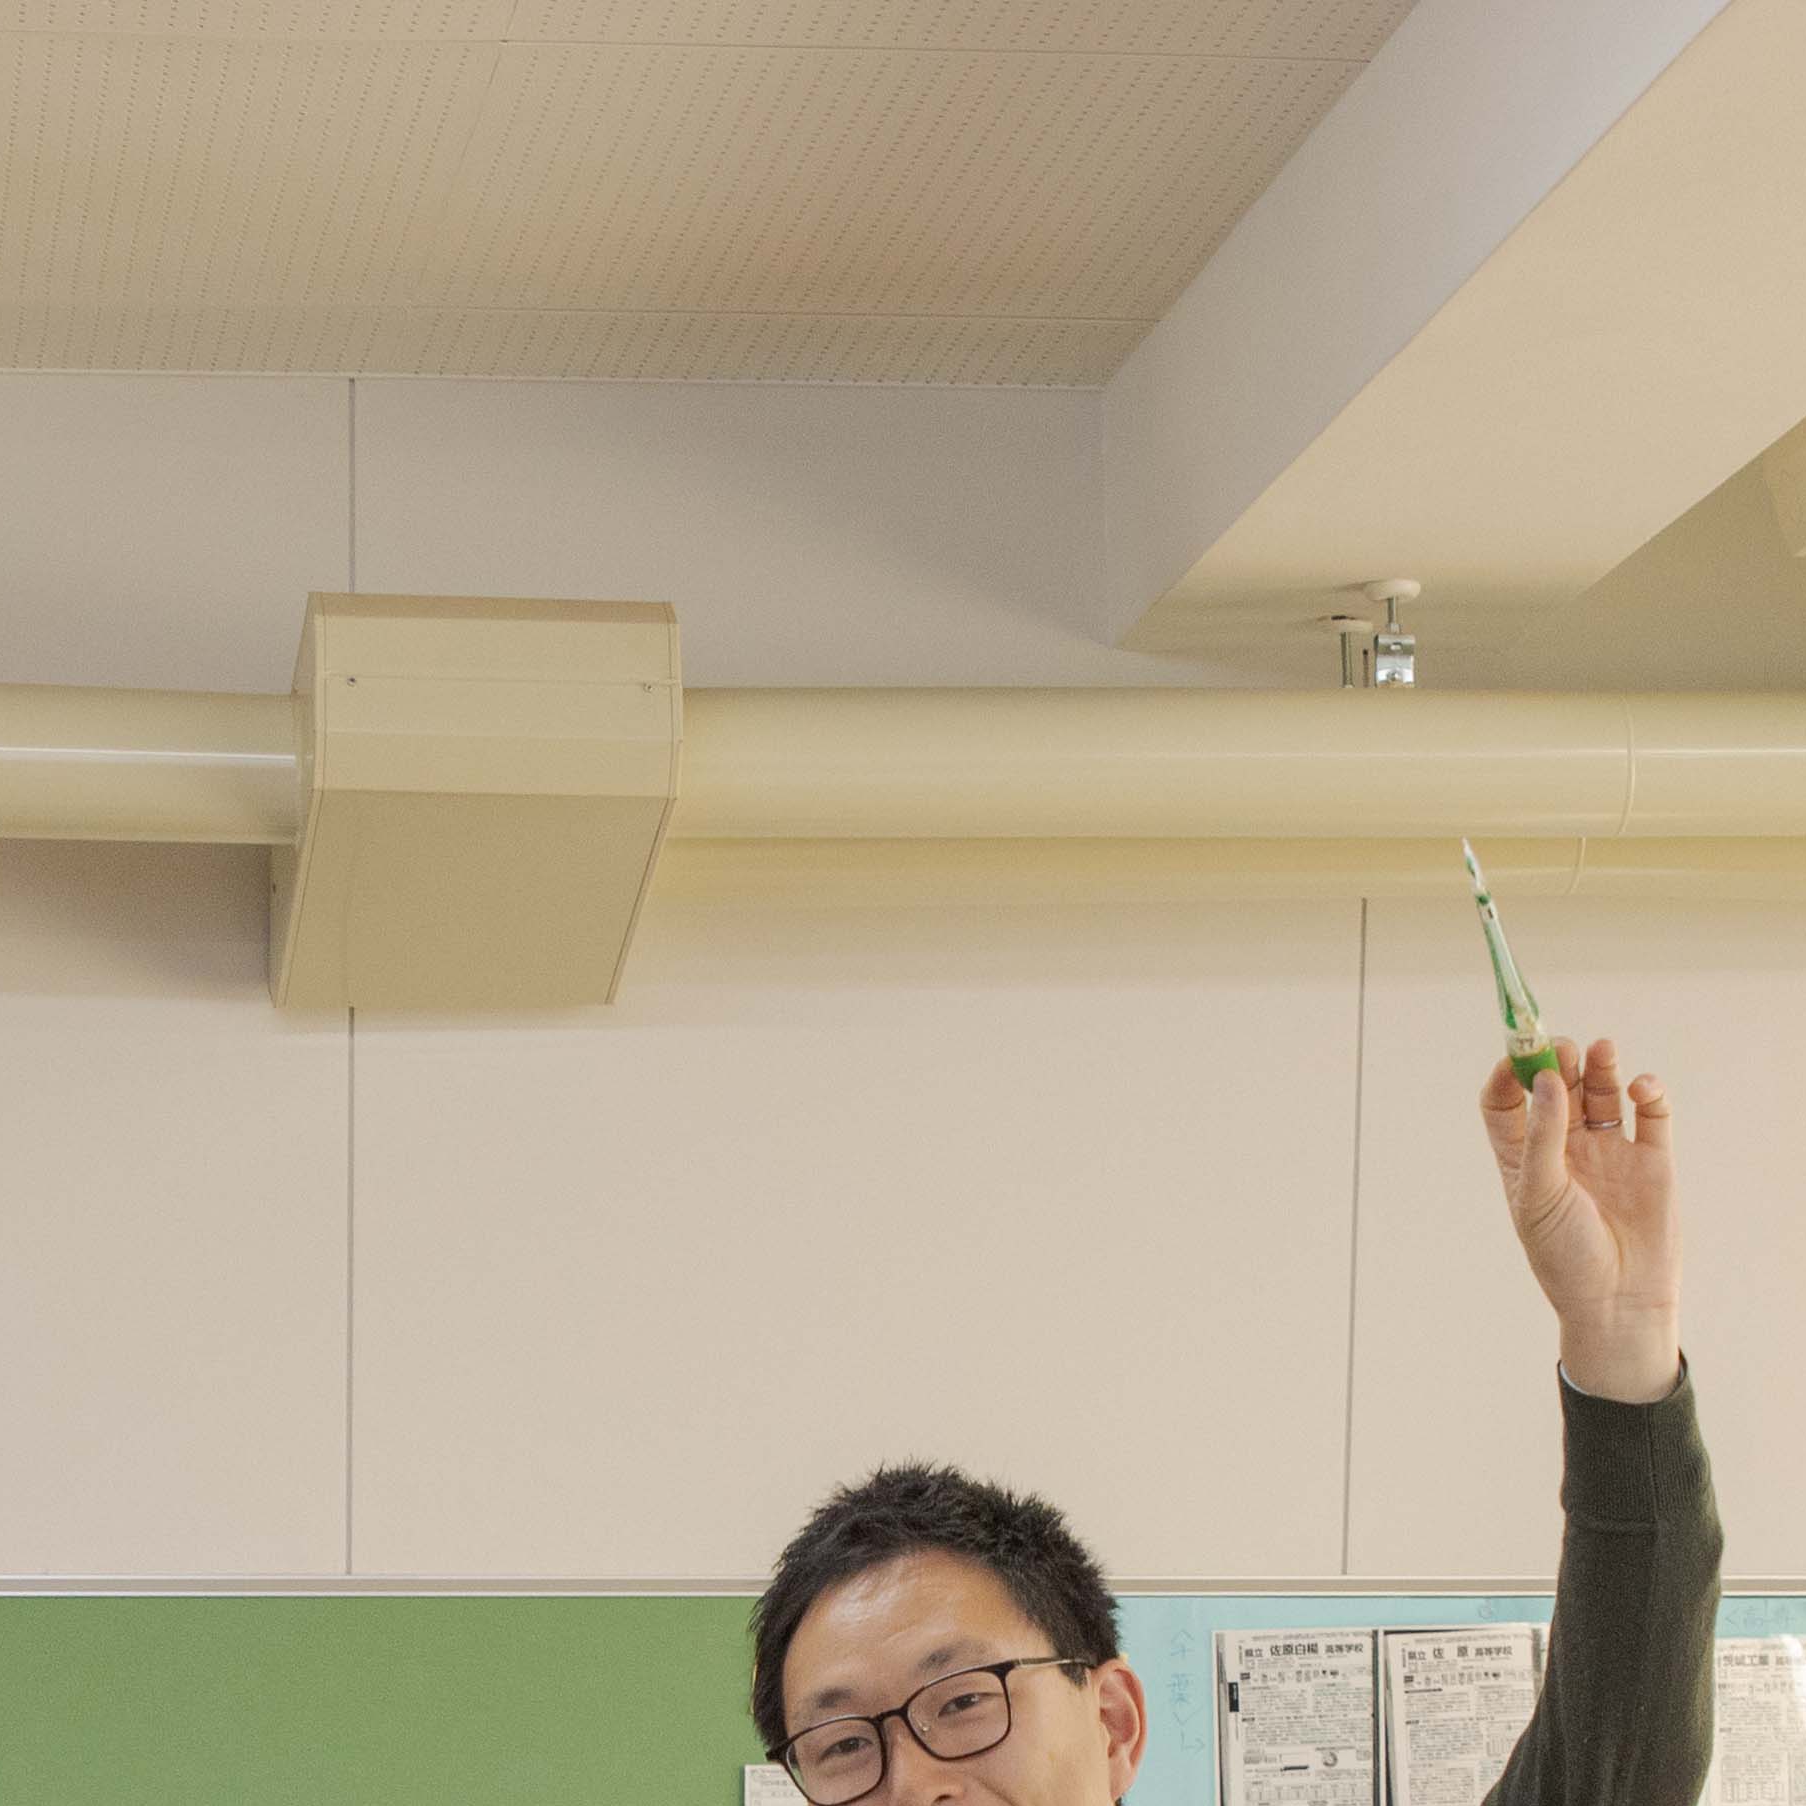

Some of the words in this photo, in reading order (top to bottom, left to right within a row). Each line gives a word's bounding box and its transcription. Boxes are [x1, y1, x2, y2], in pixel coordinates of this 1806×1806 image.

[1325, 1643, 1364, 1654] 高等学校
[1475, 1645, 1513, 1656] 高等学校
